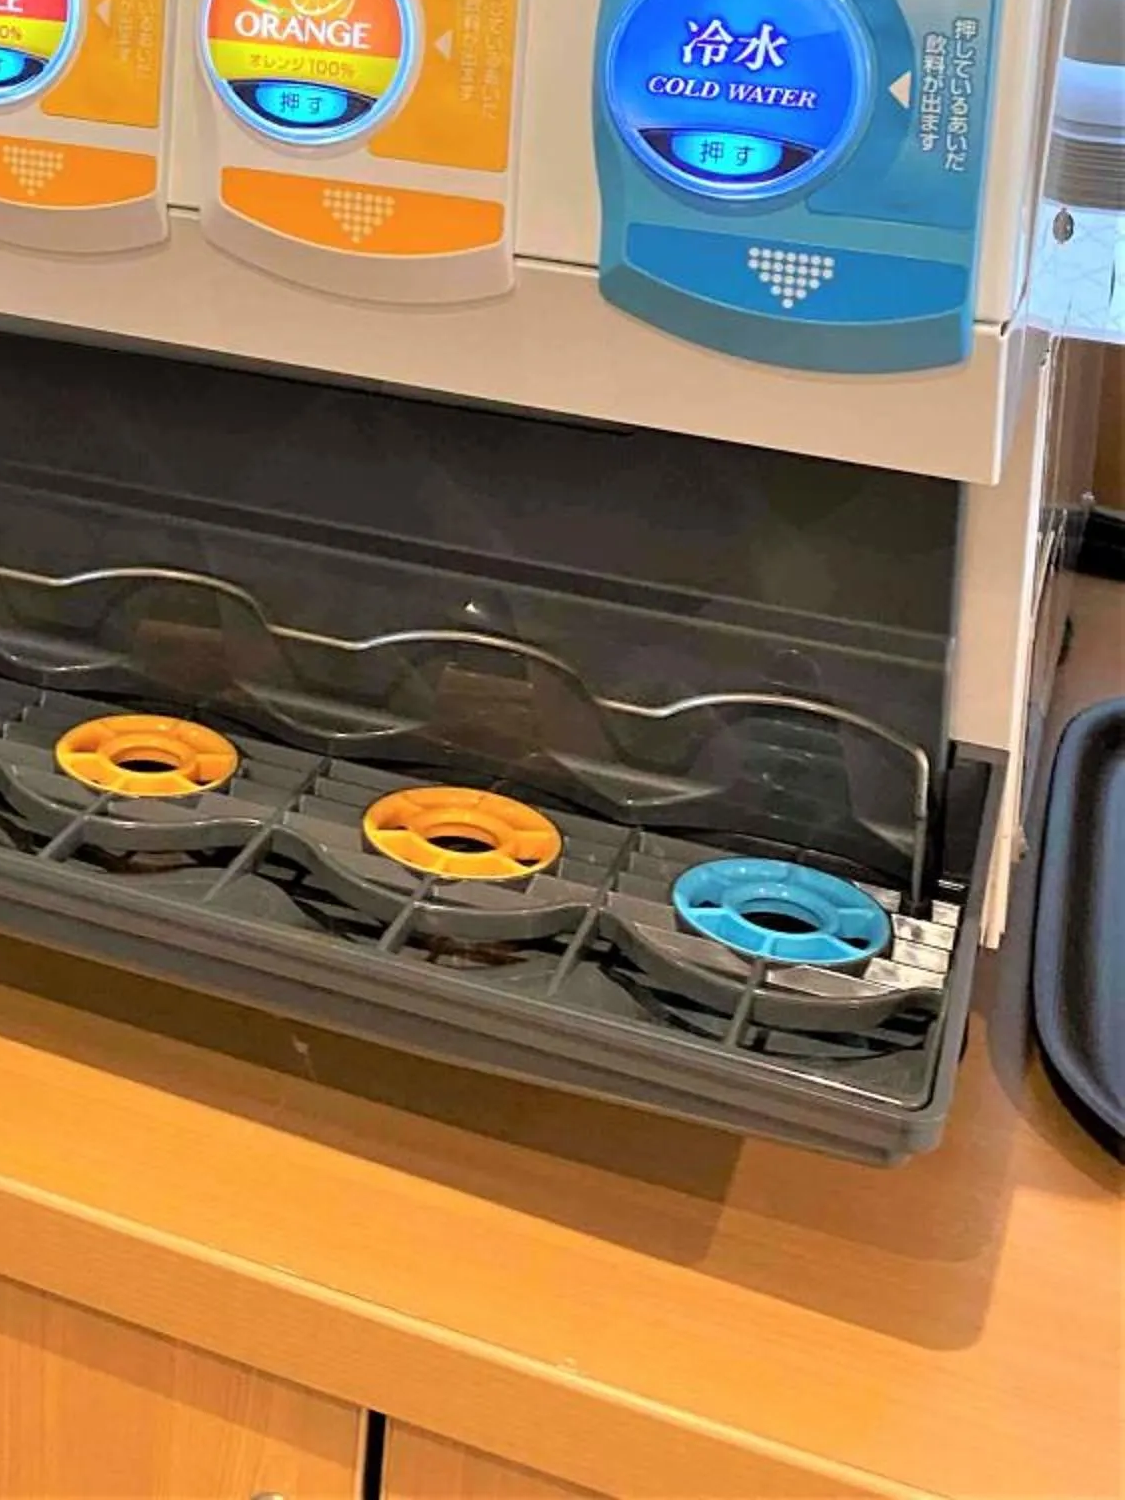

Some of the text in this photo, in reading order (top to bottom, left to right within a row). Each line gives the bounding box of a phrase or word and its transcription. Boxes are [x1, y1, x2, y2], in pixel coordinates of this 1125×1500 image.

[234, 10, 372, 49] ORANGE
[681, 18, 789, 71] 冷水
[279, 91, 324, 116] 押す
[647, 75, 818, 110] COLD WATER
[919, 32, 948, 152] 飲料が出ます
[944, 18, 980, 172] 押しているあいだ
[699, 139, 757, 166] 押す
